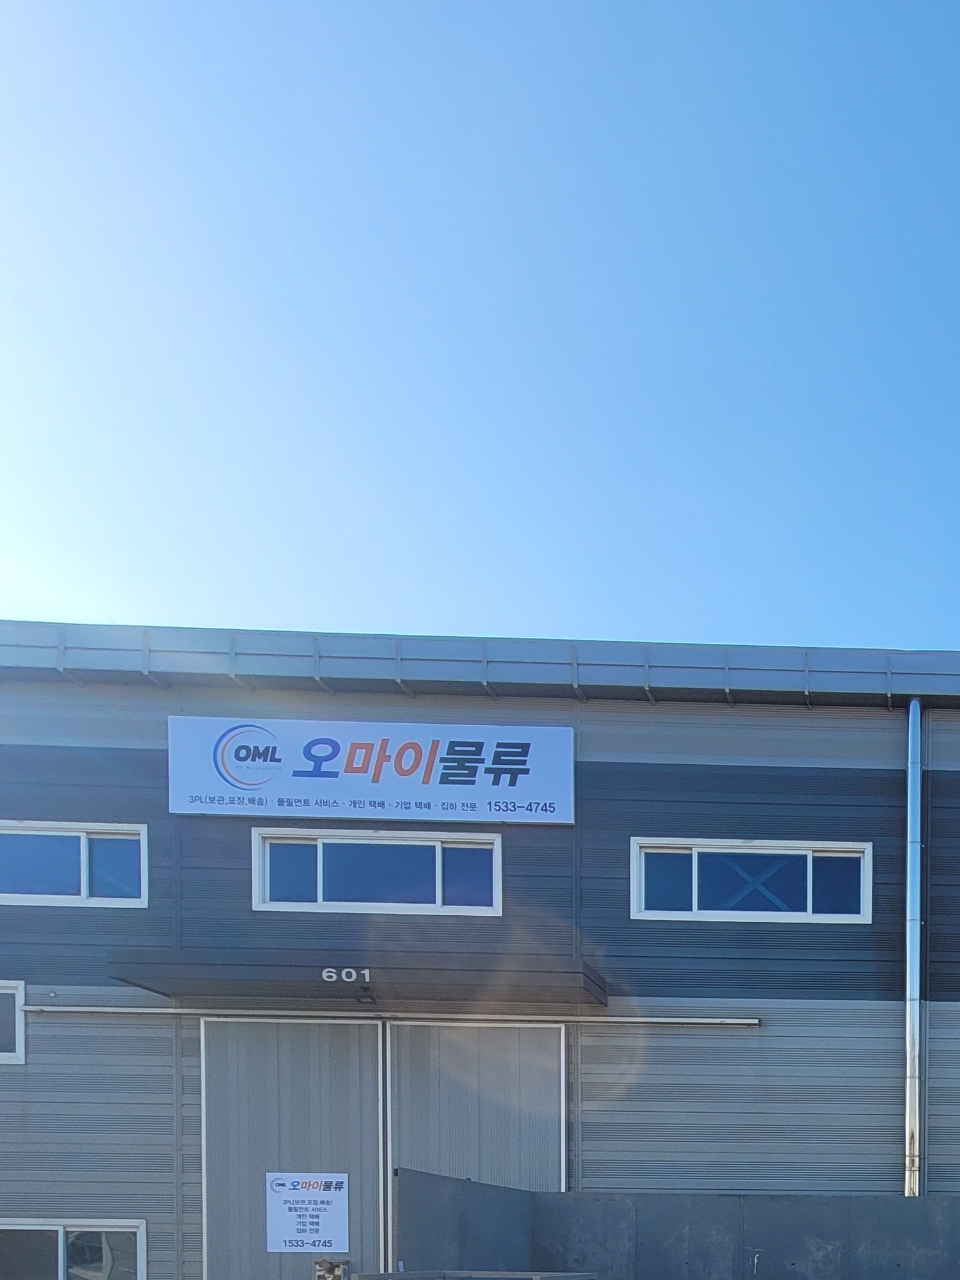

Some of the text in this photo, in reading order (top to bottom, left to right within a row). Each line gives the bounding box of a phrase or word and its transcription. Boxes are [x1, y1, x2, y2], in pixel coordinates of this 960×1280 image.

[234, 745, 282, 763] OML
[291, 737, 531, 787] 오마이물류
[314, 798, 340, 808] 서비스
[349, 799, 366, 809] 개인
[369, 800, 386, 810] 택배
[395, 801, 411, 811] 기업
[415, 801, 432, 811] 택배
[441, 802, 457, 811] 집하
[461, 802, 478, 812] 전문
[486, 801, 556, 814] 1533-4745
[321, 968, 371, 983] 601
[288, 1180, 344, 1191] 오마이물류
[283, 1239, 333, 1248] 1533-4745
